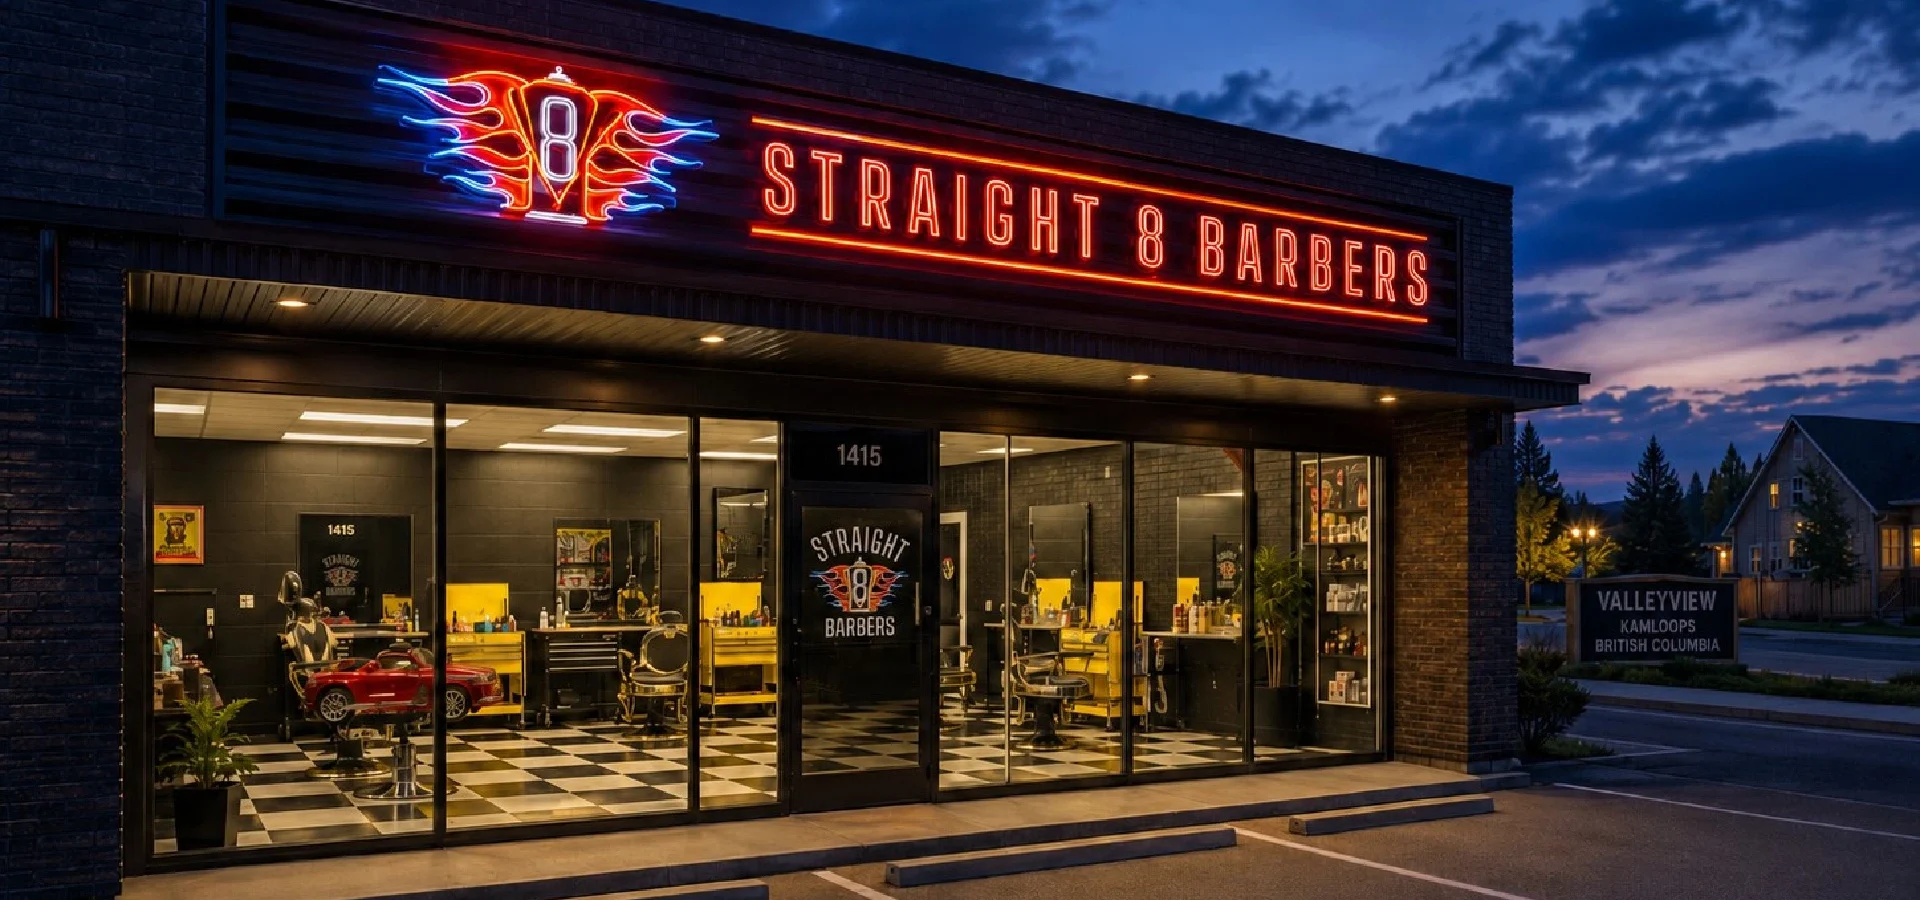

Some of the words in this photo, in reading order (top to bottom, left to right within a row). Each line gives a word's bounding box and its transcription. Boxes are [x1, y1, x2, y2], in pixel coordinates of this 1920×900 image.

[541, 97, 577, 180] 8
[764, 143, 1099, 258] STRAIGHT
[1138, 205, 1163, 268] 8
[1200, 215, 1428, 306] BARBERS
[837, 444, 882, 466] 1415
[328, 524, 355, 535] 1415
[810, 526, 911, 562] STRAIGHT
[852, 568, 868, 601] 8
[1597, 590, 1717, 611] VALLEYVIEW
[825, 616, 895, 637] BARBERS
[1620, 619, 1696, 633] KAMLOOPS
[1595, 639, 1647, 652] BRITISH
[1651, 638, 1720, 652] COLUMBIA
